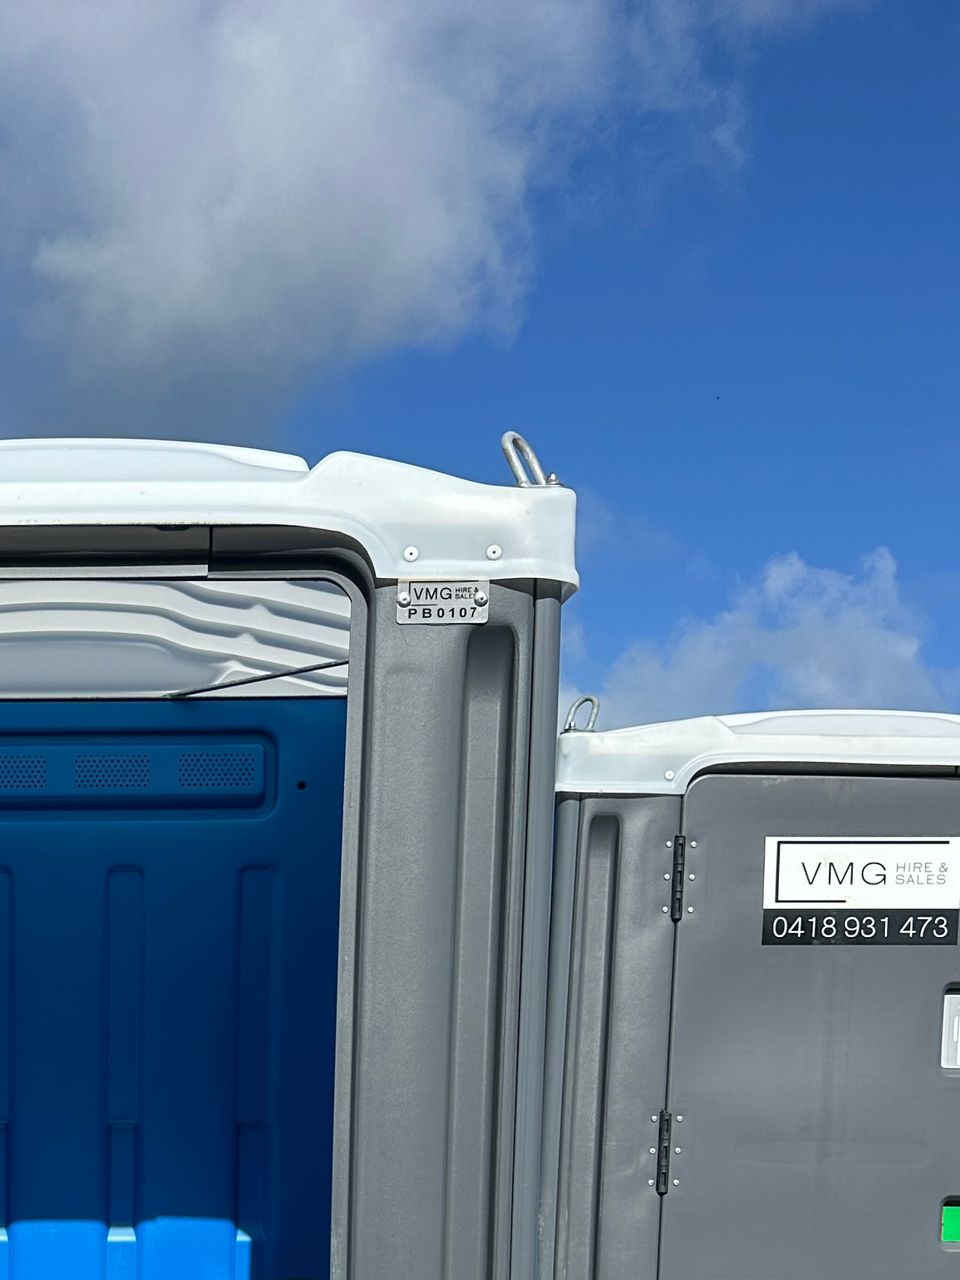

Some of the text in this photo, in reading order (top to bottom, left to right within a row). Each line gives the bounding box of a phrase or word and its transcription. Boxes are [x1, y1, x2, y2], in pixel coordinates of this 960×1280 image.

[413, 587, 452, 600] VMG
[801, 862, 886, 885] VMG
[896, 863, 949, 873] HIRE &
[895, 875, 946, 885] SALES
[772, 916, 948, 938] 0418 931 473
